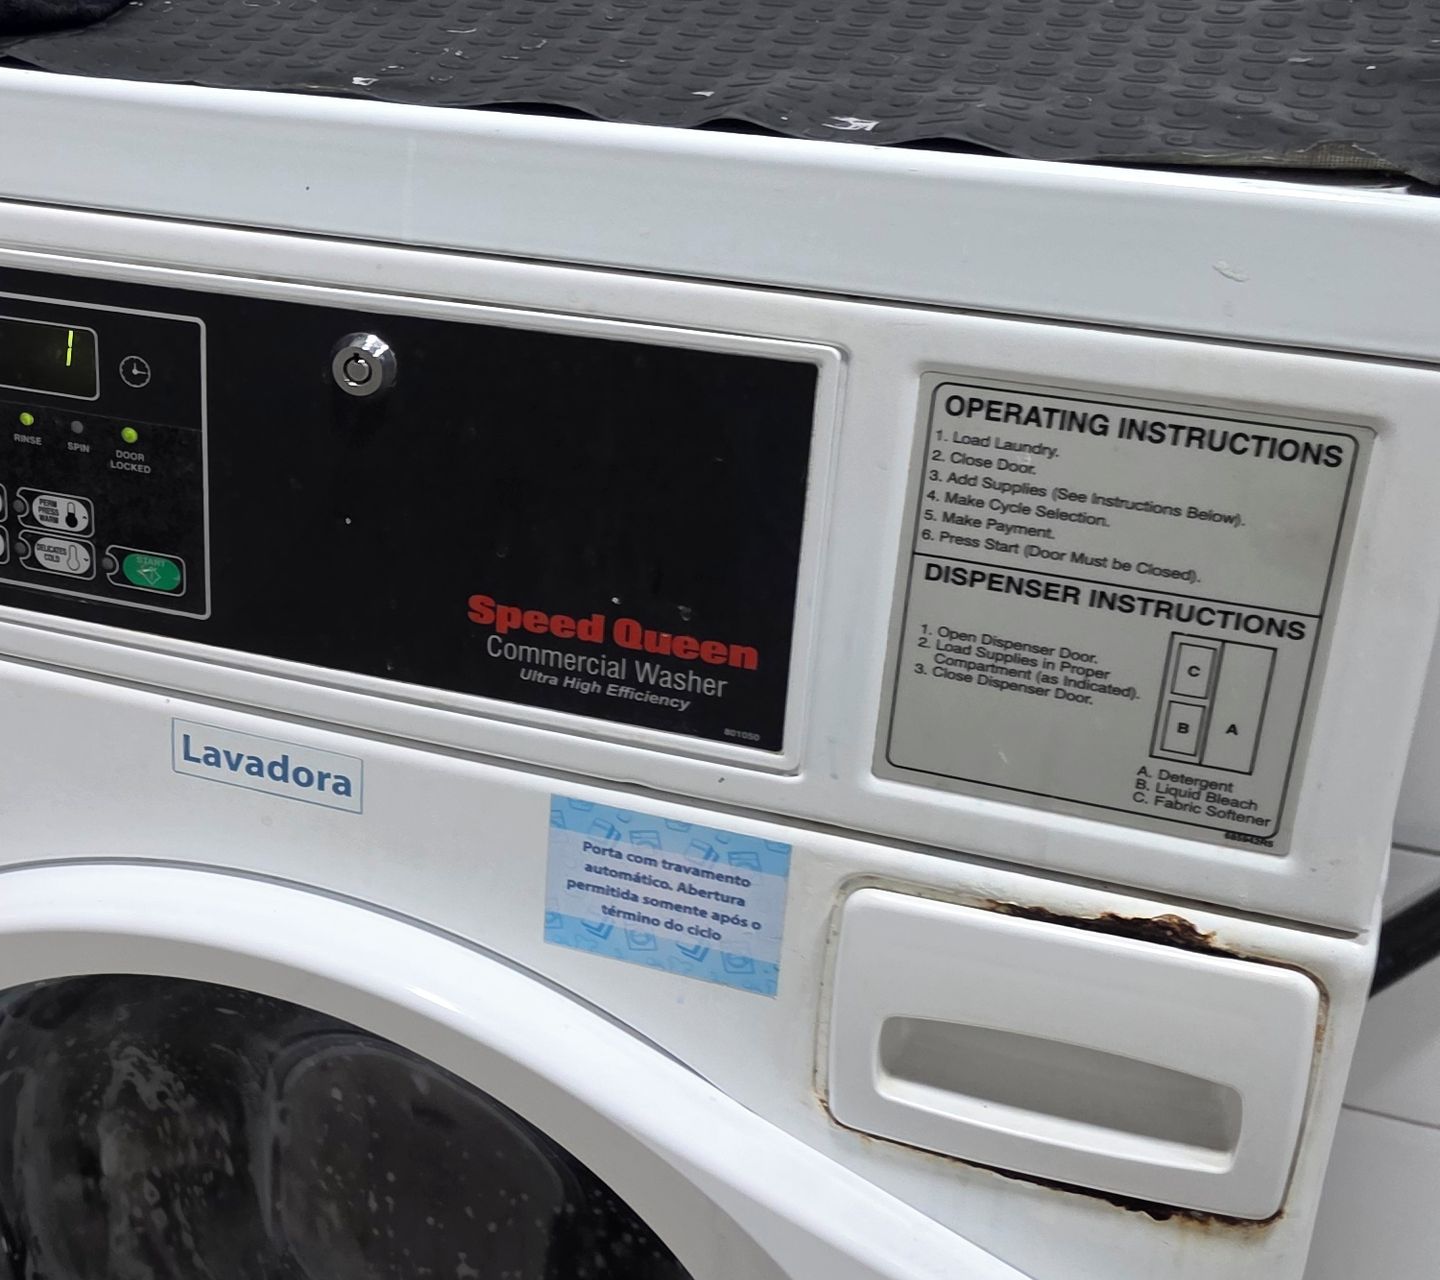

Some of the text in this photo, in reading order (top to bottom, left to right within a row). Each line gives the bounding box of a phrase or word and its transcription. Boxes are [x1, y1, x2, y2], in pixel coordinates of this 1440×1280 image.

[66, 330, 74, 367] 1
[13, 432, 42, 446] RINSE
[66, 441, 90, 453] SPIN
[935, 429, 1059, 459] 1. Load Laundry.
[944, 394, 1343, 468] OPERATING INSTRUCTIONS
[109, 459, 151, 474] LOCKED
[115, 448, 145, 462] DOOR
[930, 448, 1036, 475] 2. Close Door.
[925, 489, 1110, 527] 4. Make Cycle Selection.
[928, 468, 1245, 528] 3. Add Supplies (See Instructions Below).
[923, 508, 1055, 539] 5. Make Payment.
[135, 554, 166, 567] START
[920, 528, 1200, 584] 6. Press Start (Door Must be Closed).
[924, 562, 1306, 640] DISPENSER INSTRUCTIONS
[467, 594, 758, 670] Speed Queen
[486, 634, 728, 697] Commercial Washer
[1186, 664, 1201, 677] C
[519, 667, 691, 712] Ultra High Efficiency
[1176, 721, 1189, 734] B
[1224, 723, 1238, 735] A
[182, 733, 351, 797] Lavadora
[1135, 765, 1234, 793] A. Detergent
[1131, 790, 1272, 827] C. Fabric Softener
[1134, 777, 1258, 811] B. Liquid Bleach
[582, 840, 751, 888] Porta com travamento
[583, 862, 746, 907] automático. Abertura
[566, 878, 762, 930] permitida somente após o
[600, 904, 722, 941] término do ciclo
